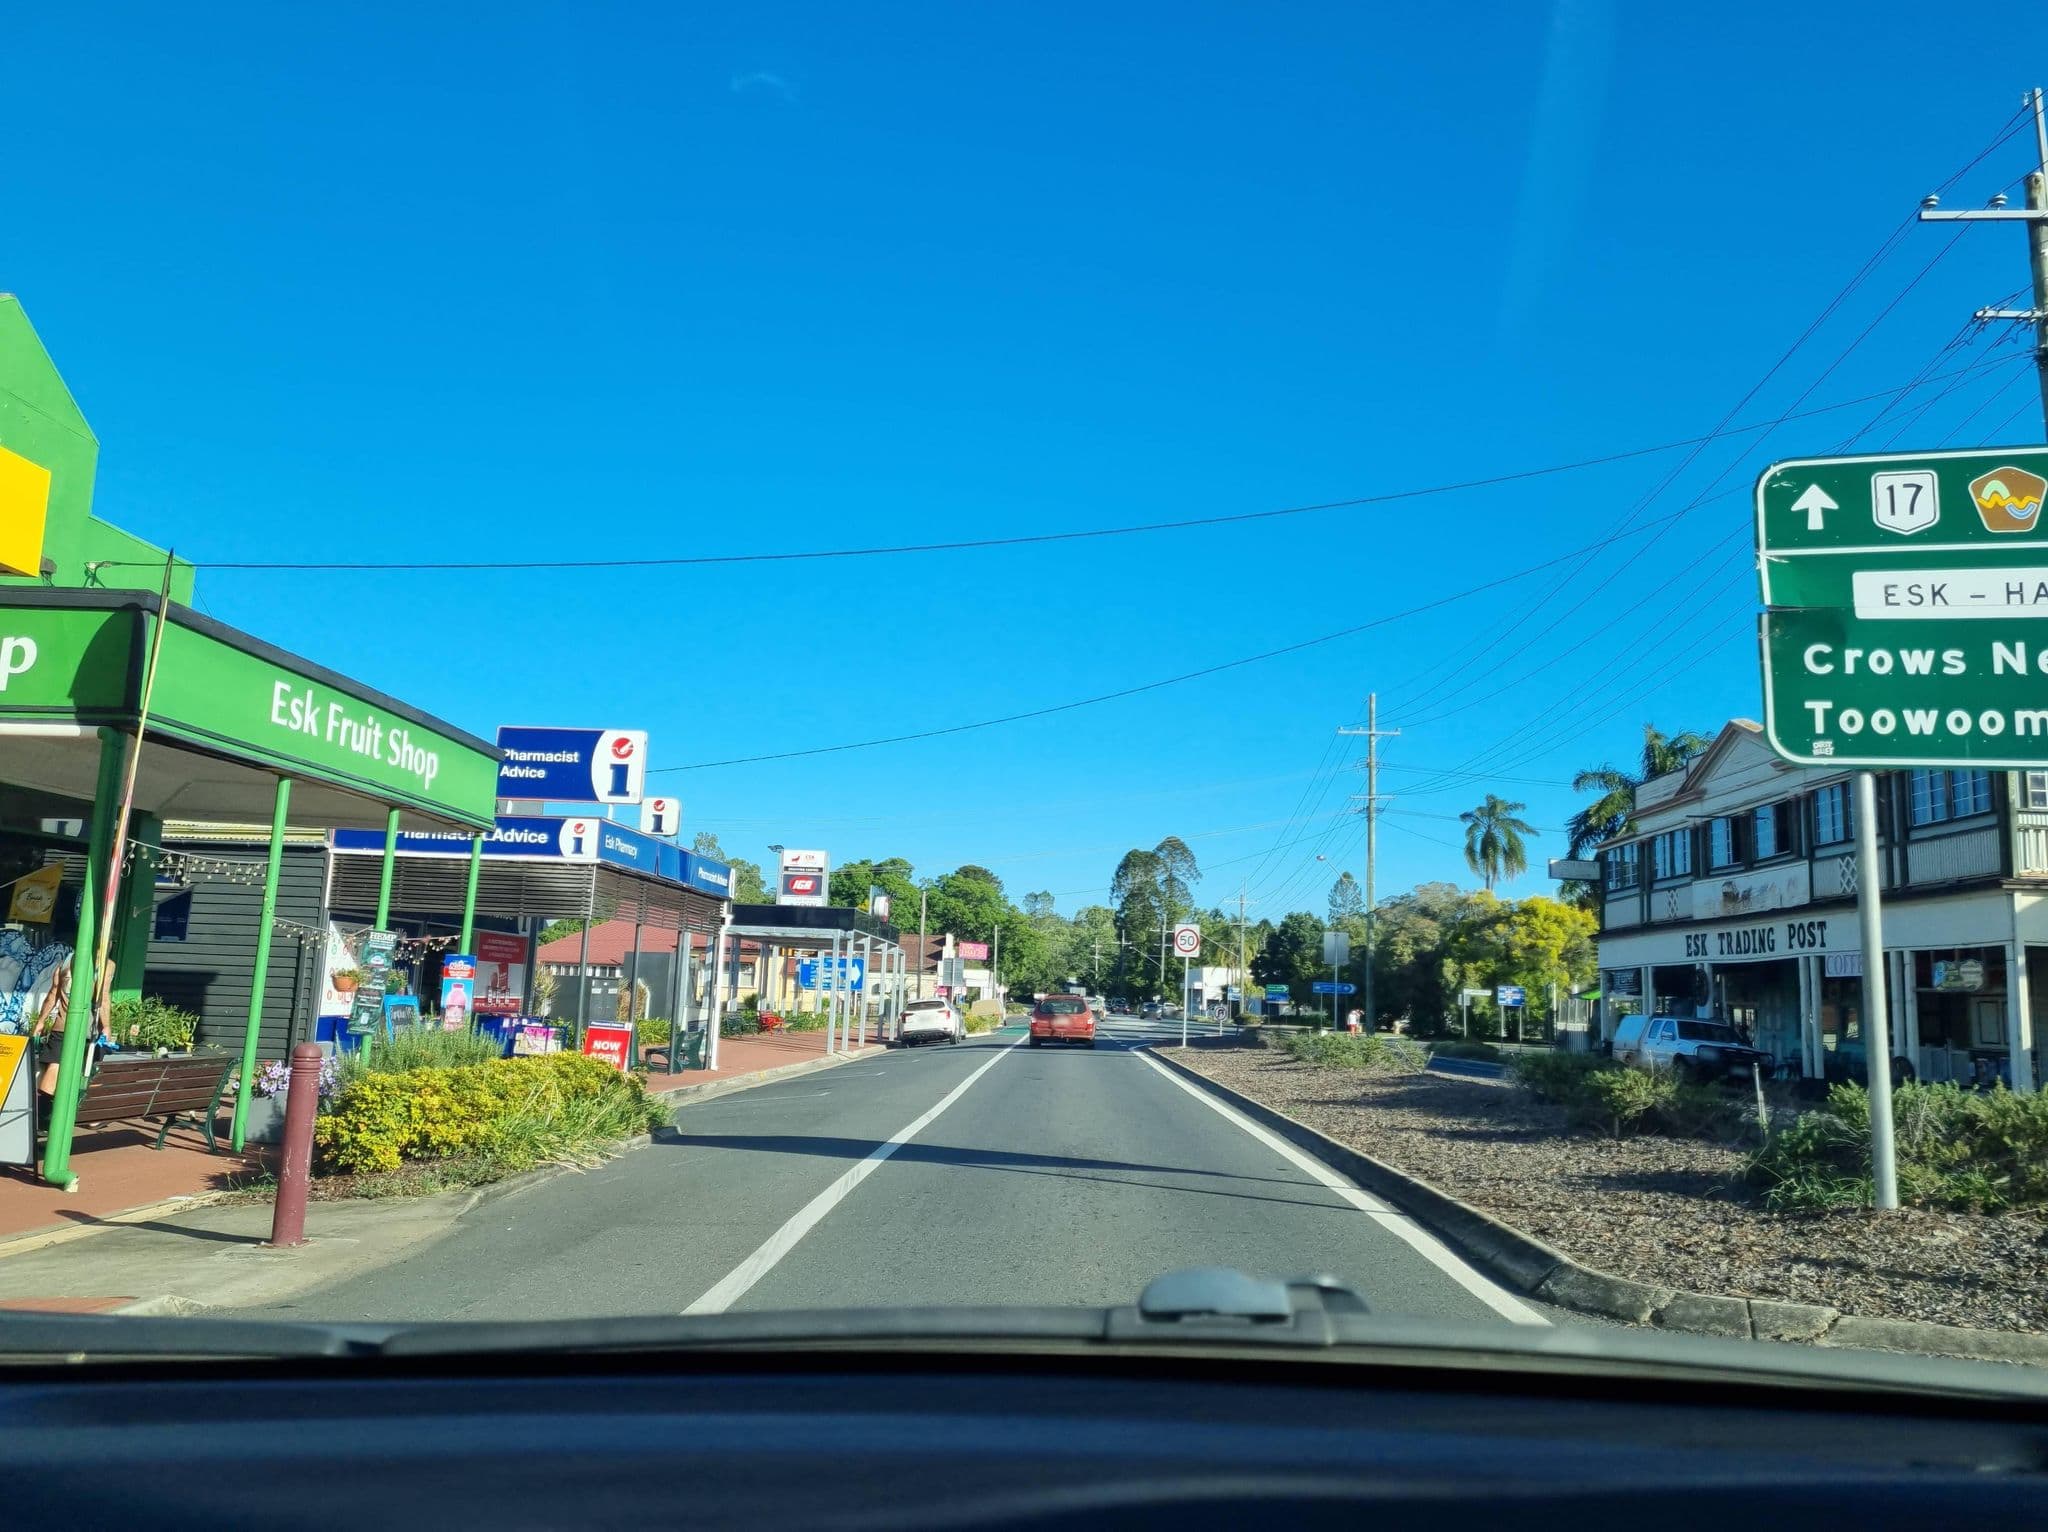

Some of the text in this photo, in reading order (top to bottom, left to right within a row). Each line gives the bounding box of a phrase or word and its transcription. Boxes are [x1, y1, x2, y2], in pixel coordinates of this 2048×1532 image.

[1886, 483, 1924, 517] 17
[1884, 583, 1950, 606] ESK
[1803, 643, 1967, 675] Crows
[1804, 700, 2048, 736] Toowoom
[271, 680, 439, 790] Esk Fruit Shop
[504, 748, 579, 763] Pharmacist
[500, 765, 546, 779] Advice
[493, 828, 548, 844] Advice
[615, 837, 638, 860] Pharmacy
[792, 879, 813, 890] IGA
[370, 931, 398, 941] HEMP
[1180, 935, 1195, 946] 50
[1686, 921, 1826, 957] ESK TRADING POST
[592, 1040, 622, 1051] NOW
